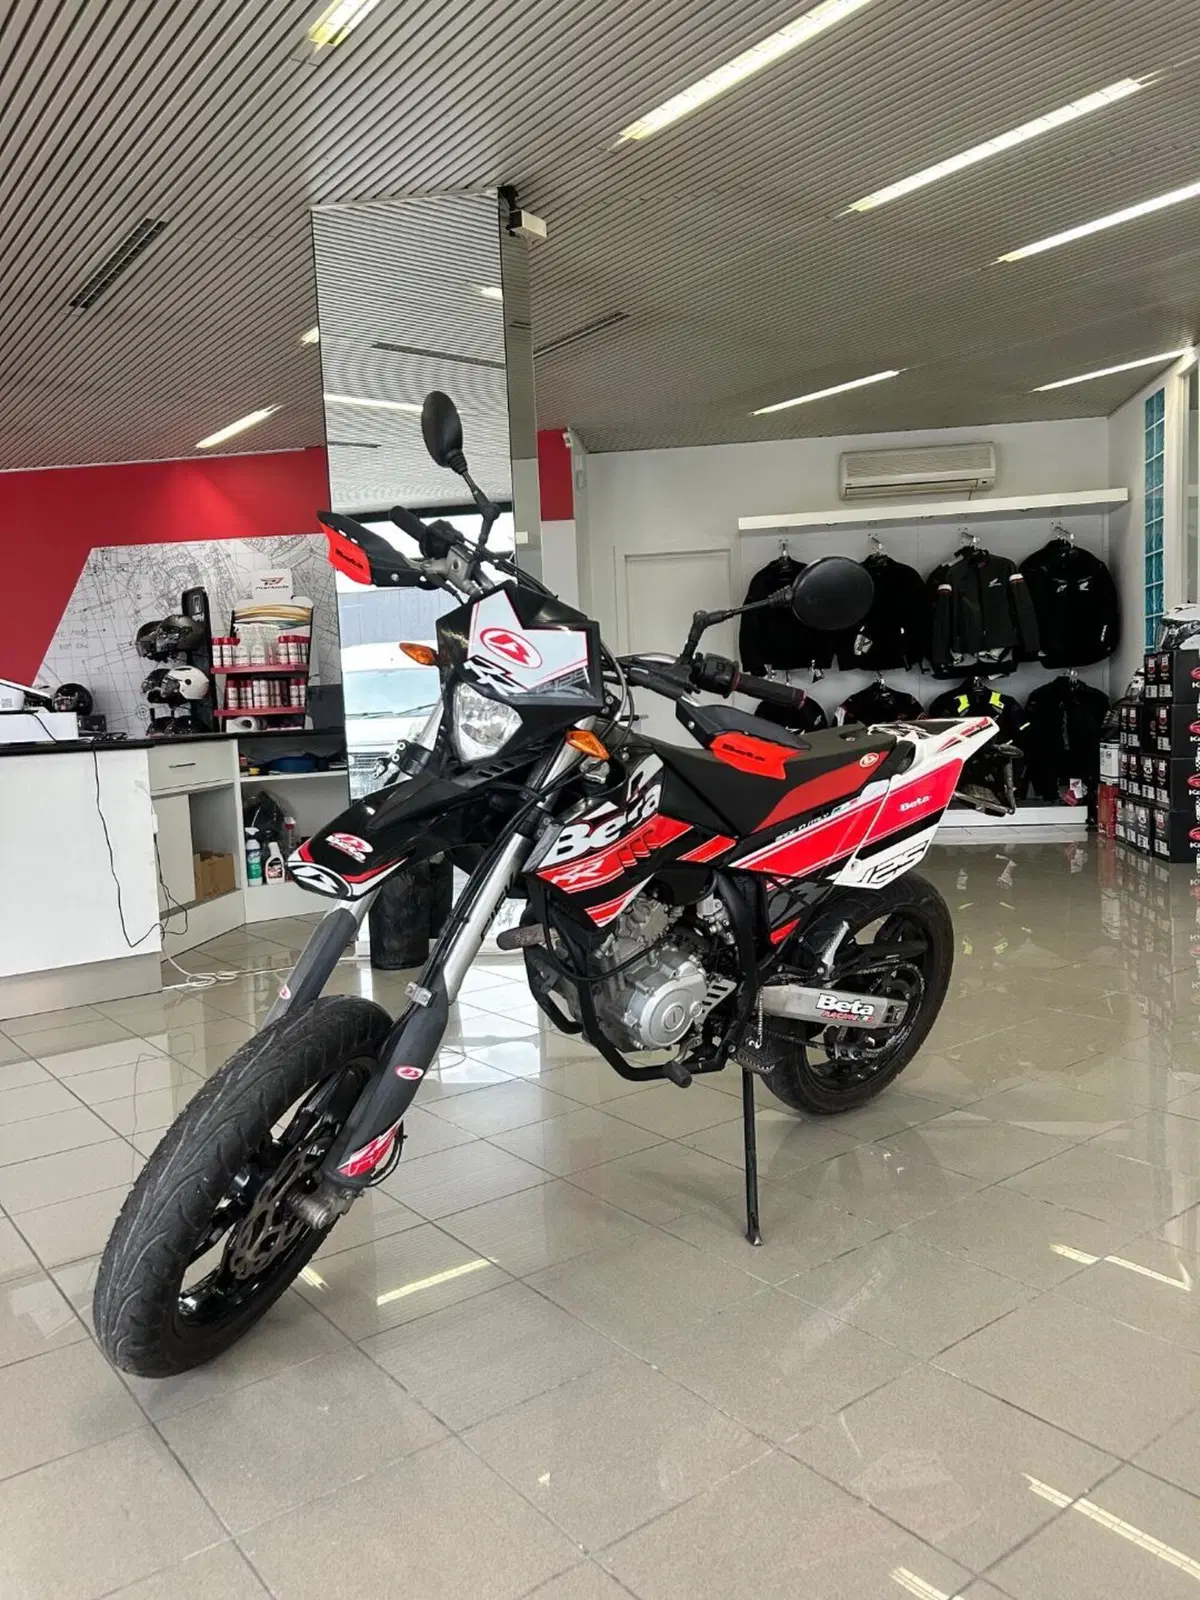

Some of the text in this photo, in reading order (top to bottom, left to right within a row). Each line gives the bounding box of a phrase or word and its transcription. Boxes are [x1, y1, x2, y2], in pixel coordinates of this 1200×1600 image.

[537, 753, 664, 868] Beta
[899, 795, 931, 812] Beta
[857, 840, 929, 884] 125
[815, 993, 875, 1016] Beta
